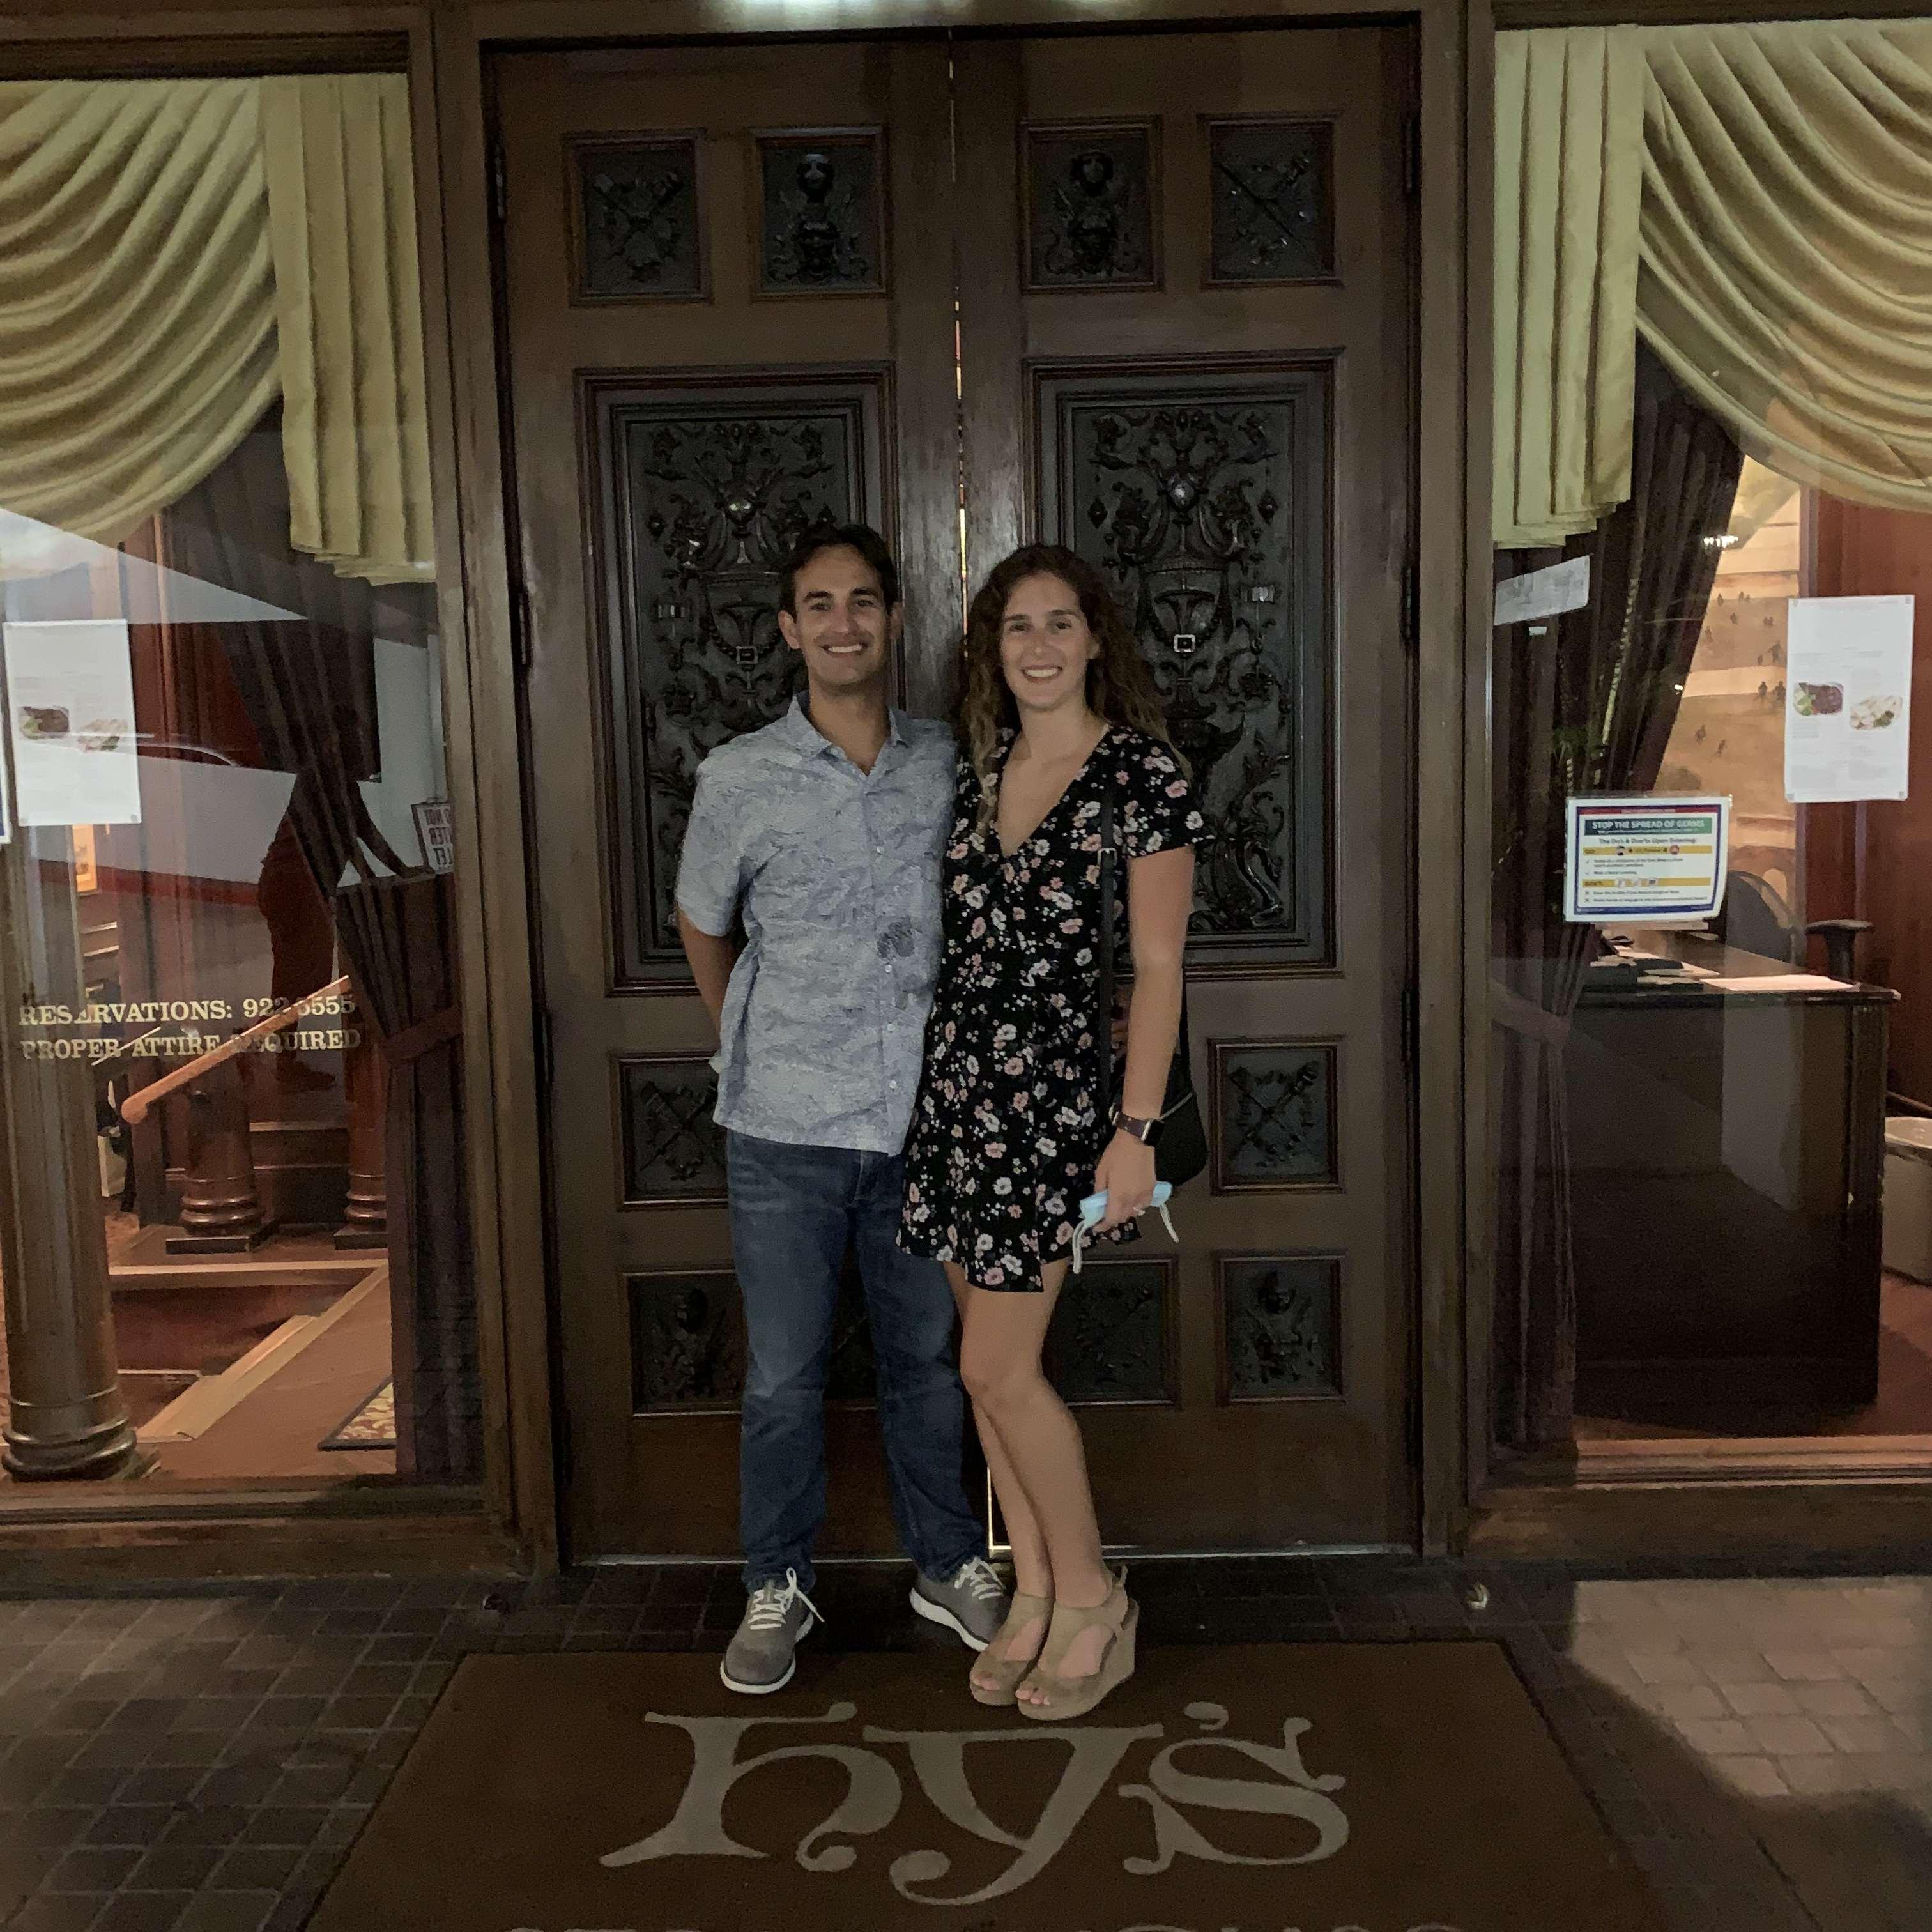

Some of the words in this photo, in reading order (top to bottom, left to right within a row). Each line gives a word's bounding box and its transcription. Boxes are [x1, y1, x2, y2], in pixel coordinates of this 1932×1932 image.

[1592, 821, 1613, 829] STOP
[1614, 821, 1630, 829] THE
[1631, 820, 1663, 829] SPREAD
[1664, 820, 1675, 828] OF
[20, 1038, 121, 1060] PROPER
